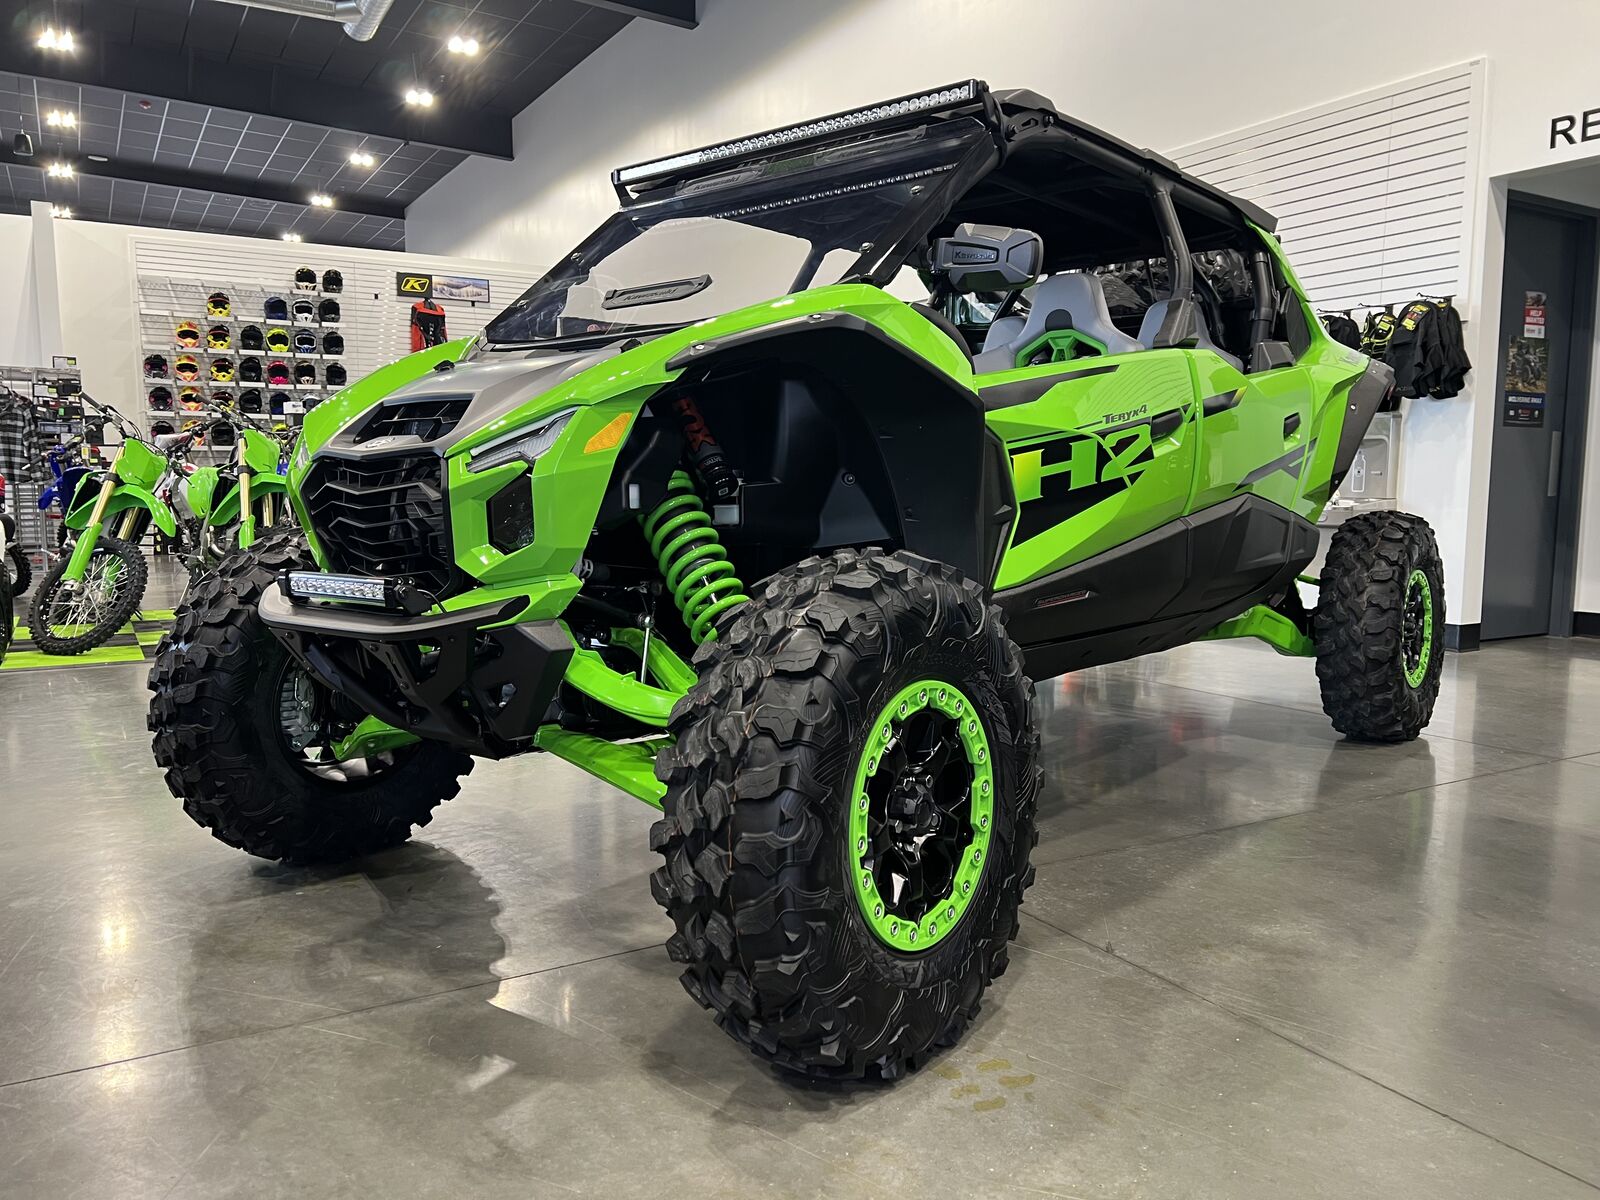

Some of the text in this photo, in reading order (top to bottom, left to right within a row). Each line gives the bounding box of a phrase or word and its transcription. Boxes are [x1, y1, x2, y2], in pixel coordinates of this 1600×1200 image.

[1550, 107, 1600, 149] RE
[623, 287, 678, 301] Kawasaki
[1012, 423, 1154, 504] H2
